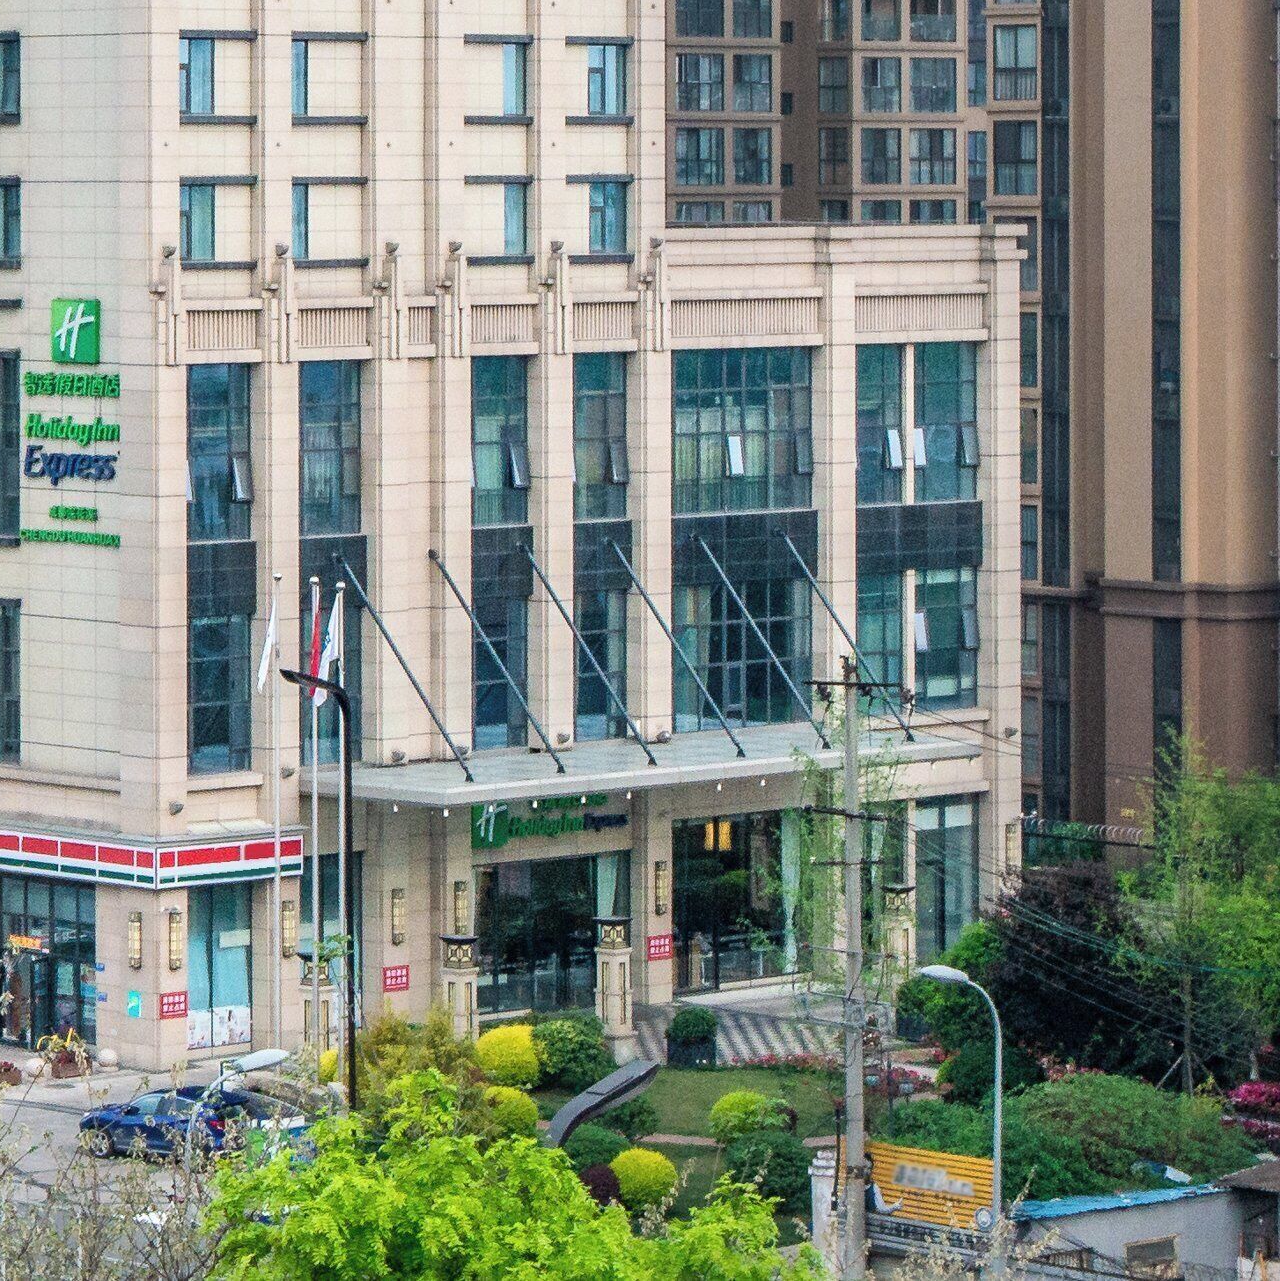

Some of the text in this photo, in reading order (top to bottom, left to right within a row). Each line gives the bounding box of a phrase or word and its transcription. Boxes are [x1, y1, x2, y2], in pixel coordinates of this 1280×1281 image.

[24, 371, 120, 398] 智选假日酒店
[25, 413, 120, 447] Holiday Inn
[24, 444, 117, 486] Express
